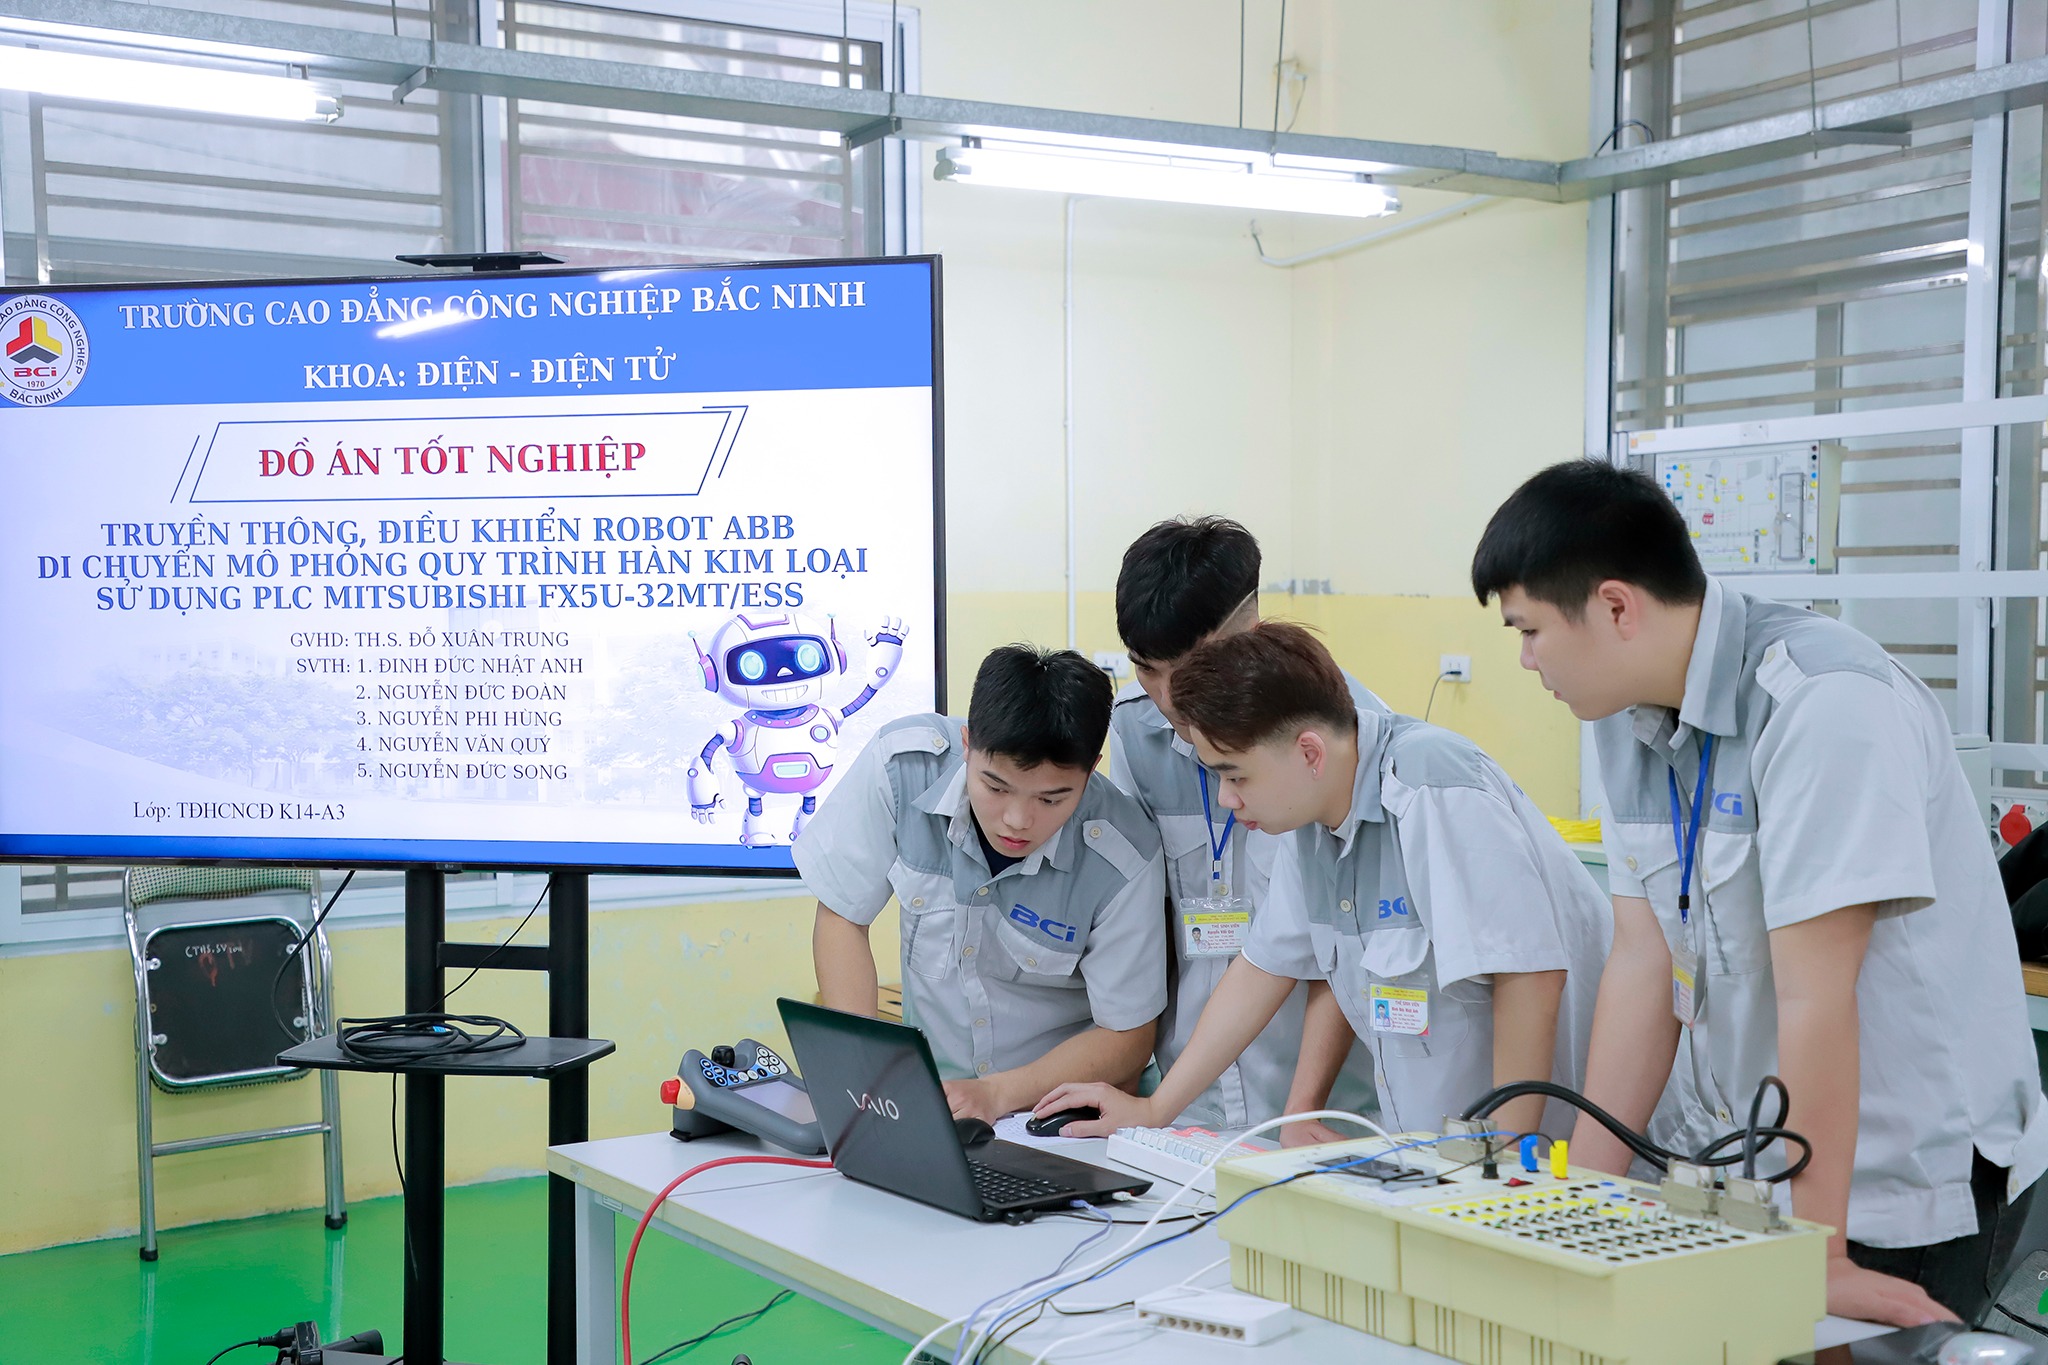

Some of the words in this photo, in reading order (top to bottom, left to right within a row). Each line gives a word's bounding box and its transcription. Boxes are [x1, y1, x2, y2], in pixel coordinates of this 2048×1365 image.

[118, 297, 255, 329] TRƯỜNG
[265, 299, 330, 326] CAO
[341, 286, 433, 324] ĐẲNG
[444, 290, 538, 320] CÔNG
[549, 283, 681, 320] NGHIỆP
[692, 276, 761, 313] BẮC
[772, 281, 866, 310] NINH
[304, 362, 406, 389] KHOA:
[417, 356, 499, 391] ĐIỆN
[531, 352, 614, 389] ĐIỆN
[624, 346, 677, 381] TỬ
[34, 388, 63, 404] NINH
[259, 437, 315, 478] ĐỒ
[326, 440, 381, 476] ÁN
[394, 434, 474, 476] TỐT
[487, 436, 646, 478] NGHIỆP
[101, 512, 231, 547] TRUYỀN
[240, 516, 367, 549] THÔNG,
[379, 510, 458, 544] ĐIỀU
[472, 507, 581, 543] KHIỂN
[593, 515, 713, 542] ROBOT
[722, 514, 795, 541] ABB
[38, 555, 71, 579] DI
[82, 542, 215, 578] CHUYỂN
[226, 549, 279, 578] MÔ
[290, 545, 408, 577] PHỎNG
[419, 552, 486, 581] QUY
[496, 545, 607, 576] TRÌNH
[618, 545, 692, 575] HÀN
[705, 548, 774, 574] KIM
[786, 547, 868, 579] LOẠI
[96, 578, 144, 611] SỬ
[148, 585, 241, 615] DỤNG
[253, 585, 312, 610] PLC
[323, 583, 530, 610] MITSUBISHI
[539, 581, 804, 609] FX5U-32MT/ESS
[290, 632, 349, 648] GVHD:
[354, 632, 402, 648] TH.S.
[408, 626, 436, 648] ĐỖ
[441, 627, 495, 647] XUÂN
[501, 631, 569, 647] TRUNG
[297, 658, 351, 674] SVTH:
[358, 658, 371, 674] 1.
[379, 658, 428, 674] ĐINH
[435, 653, 476, 674] ĐỨC
[481, 653, 535, 677] NHẬT
[540, 658, 583, 674] ANH
[356, 684, 371, 700] 2.
[377, 679, 458, 700] NGUYỄN
[465, 680, 506, 700] ĐỨC
[512, 680, 567, 701] ĐOÀN
[356, 711, 371, 726] 3.
[379, 705, 458, 727] NGUYỄN
[465, 711, 498, 727] PHI
[504, 706, 562, 727] HÙNG
[356, 737, 371, 752] 4.
[379, 731, 459, 753] NGUYỄN
[466, 732, 503, 753] VĂN
[510, 732, 551, 757] QUÝ
[357, 763, 372, 778] 5.
[379, 757, 459, 779] NGUYỄN
[466, 760, 508, 779] ĐỨC
[513, 764, 567, 780] SONG
[134, 801, 171, 823] Lớp:
[177, 802, 273, 820] TĐHCNCĐ
[279, 803, 346, 821] K14-A3
[1712, 788, 1743, 816] Ci
[846, 1089, 900, 1121] VAIO
